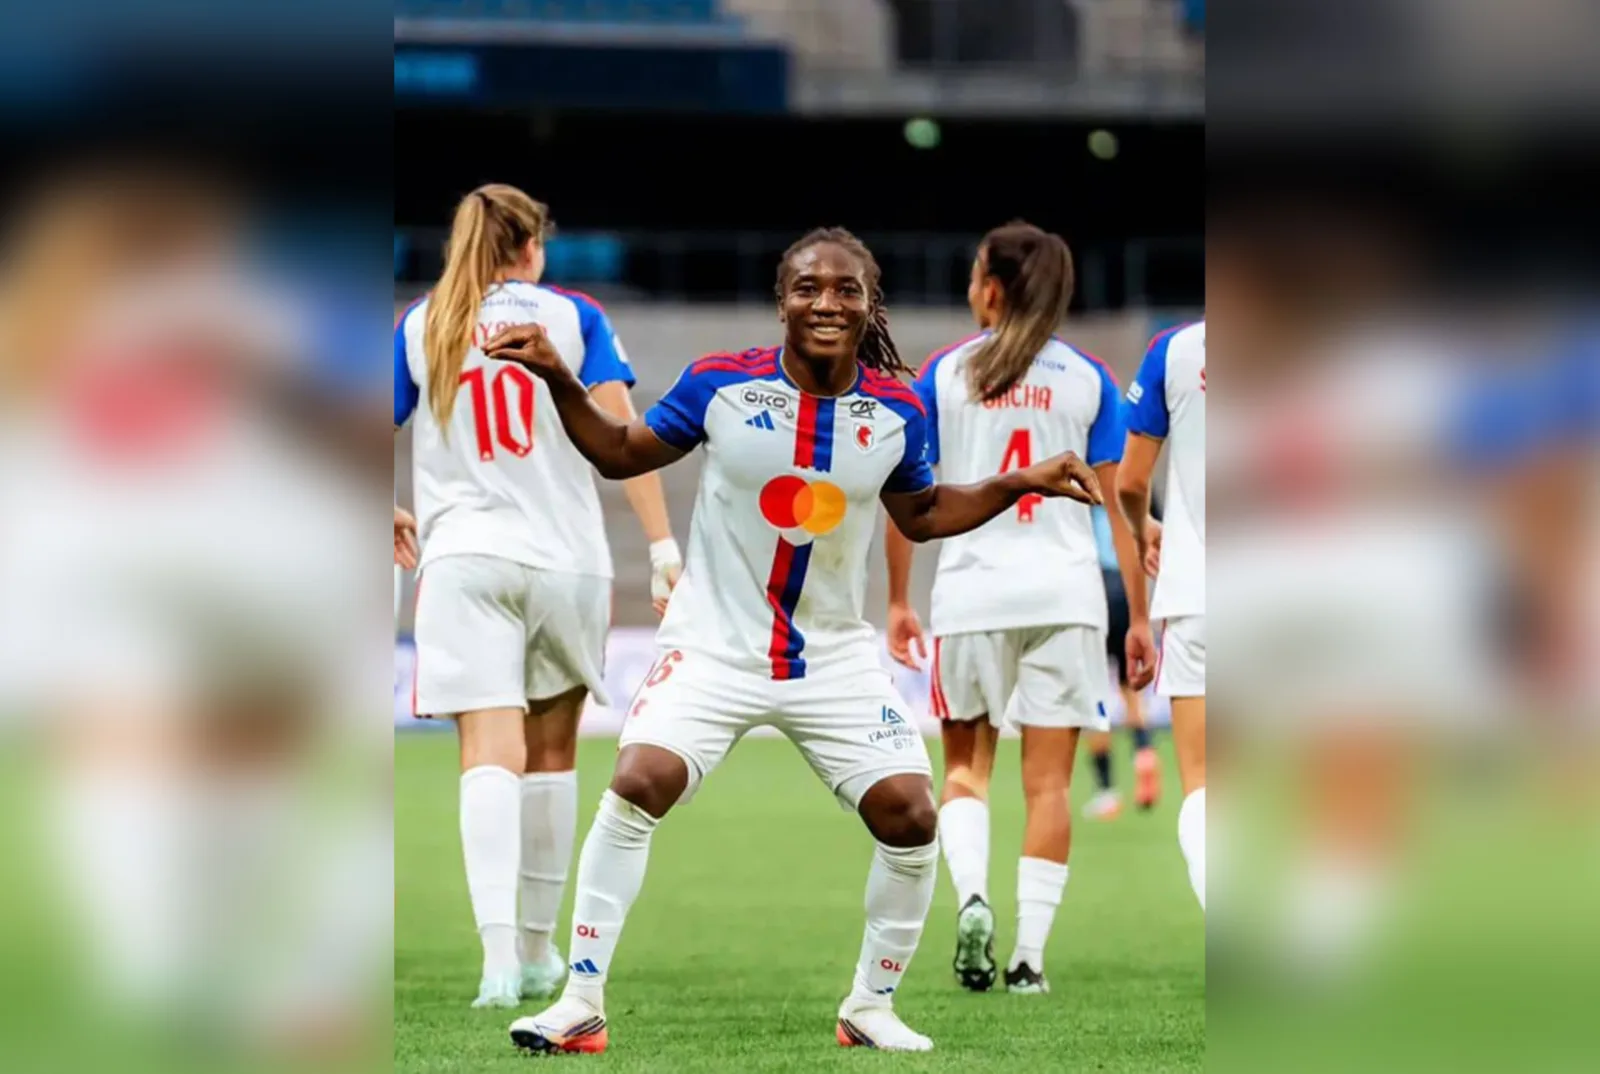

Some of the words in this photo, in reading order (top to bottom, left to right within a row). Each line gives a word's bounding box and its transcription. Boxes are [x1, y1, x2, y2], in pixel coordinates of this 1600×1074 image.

[458, 364, 535, 462] 10
[998, 428, 1043, 524] 4
[576, 924, 600, 939] OL
[880, 958, 903, 972] OL
